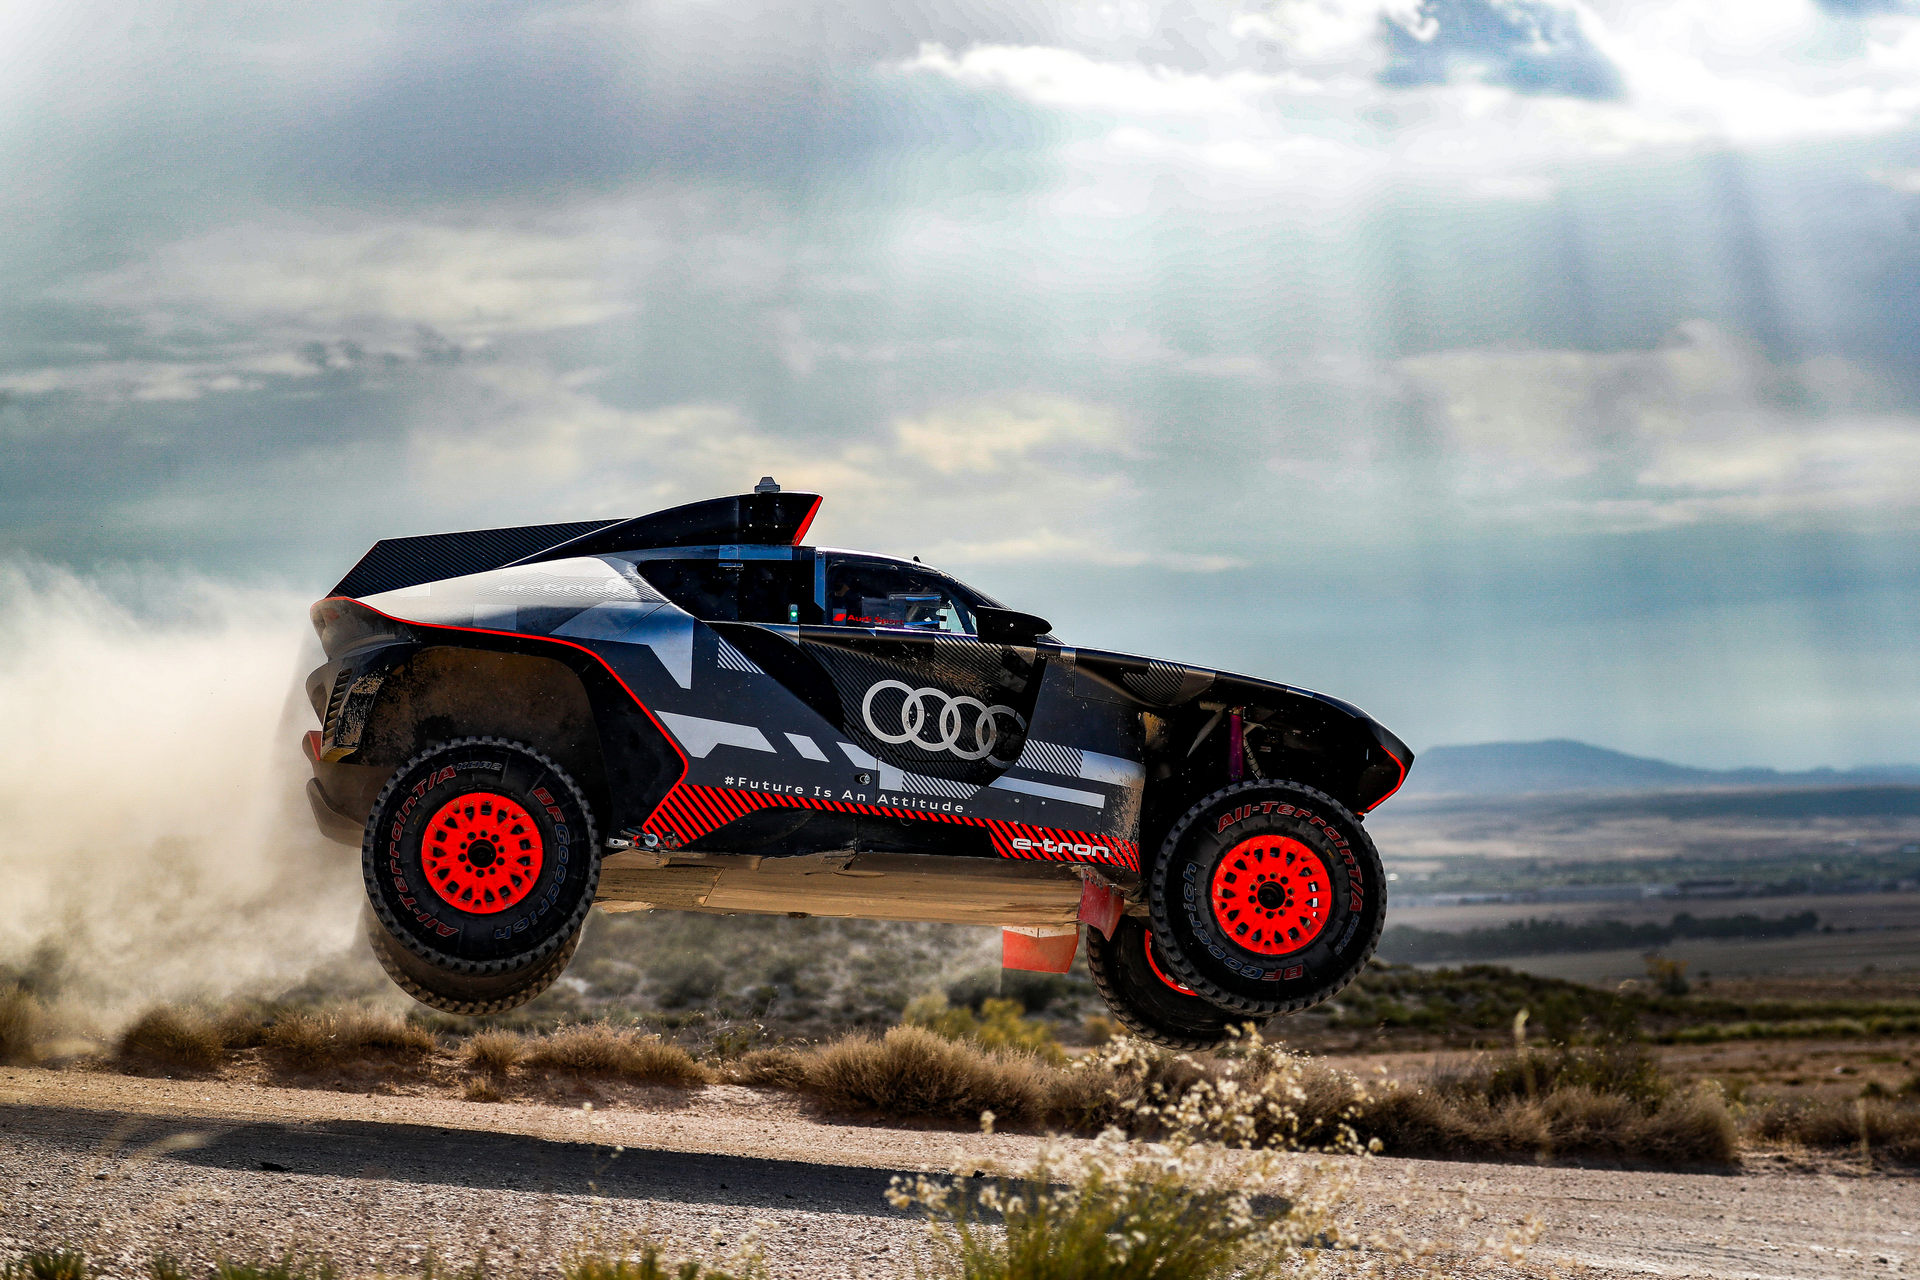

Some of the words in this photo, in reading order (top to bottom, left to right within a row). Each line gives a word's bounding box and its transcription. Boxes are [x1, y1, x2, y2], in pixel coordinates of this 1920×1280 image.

[847, 614, 872, 623] Audi
[874, 616, 905, 626] Sport
[411, 765, 456, 798] T/A
[724, 776, 804, 795] #Future
[814, 786, 832, 797] Is
[841, 789, 866, 802] An
[1012, 837, 1109, 858] e-tron
[1217, 801, 1355, 865] All-Terrain
[389, 796, 460, 937] All-Terrain
[495, 786, 571, 940] BFGoodrich
[1182, 862, 1304, 982] BFGoodrich
